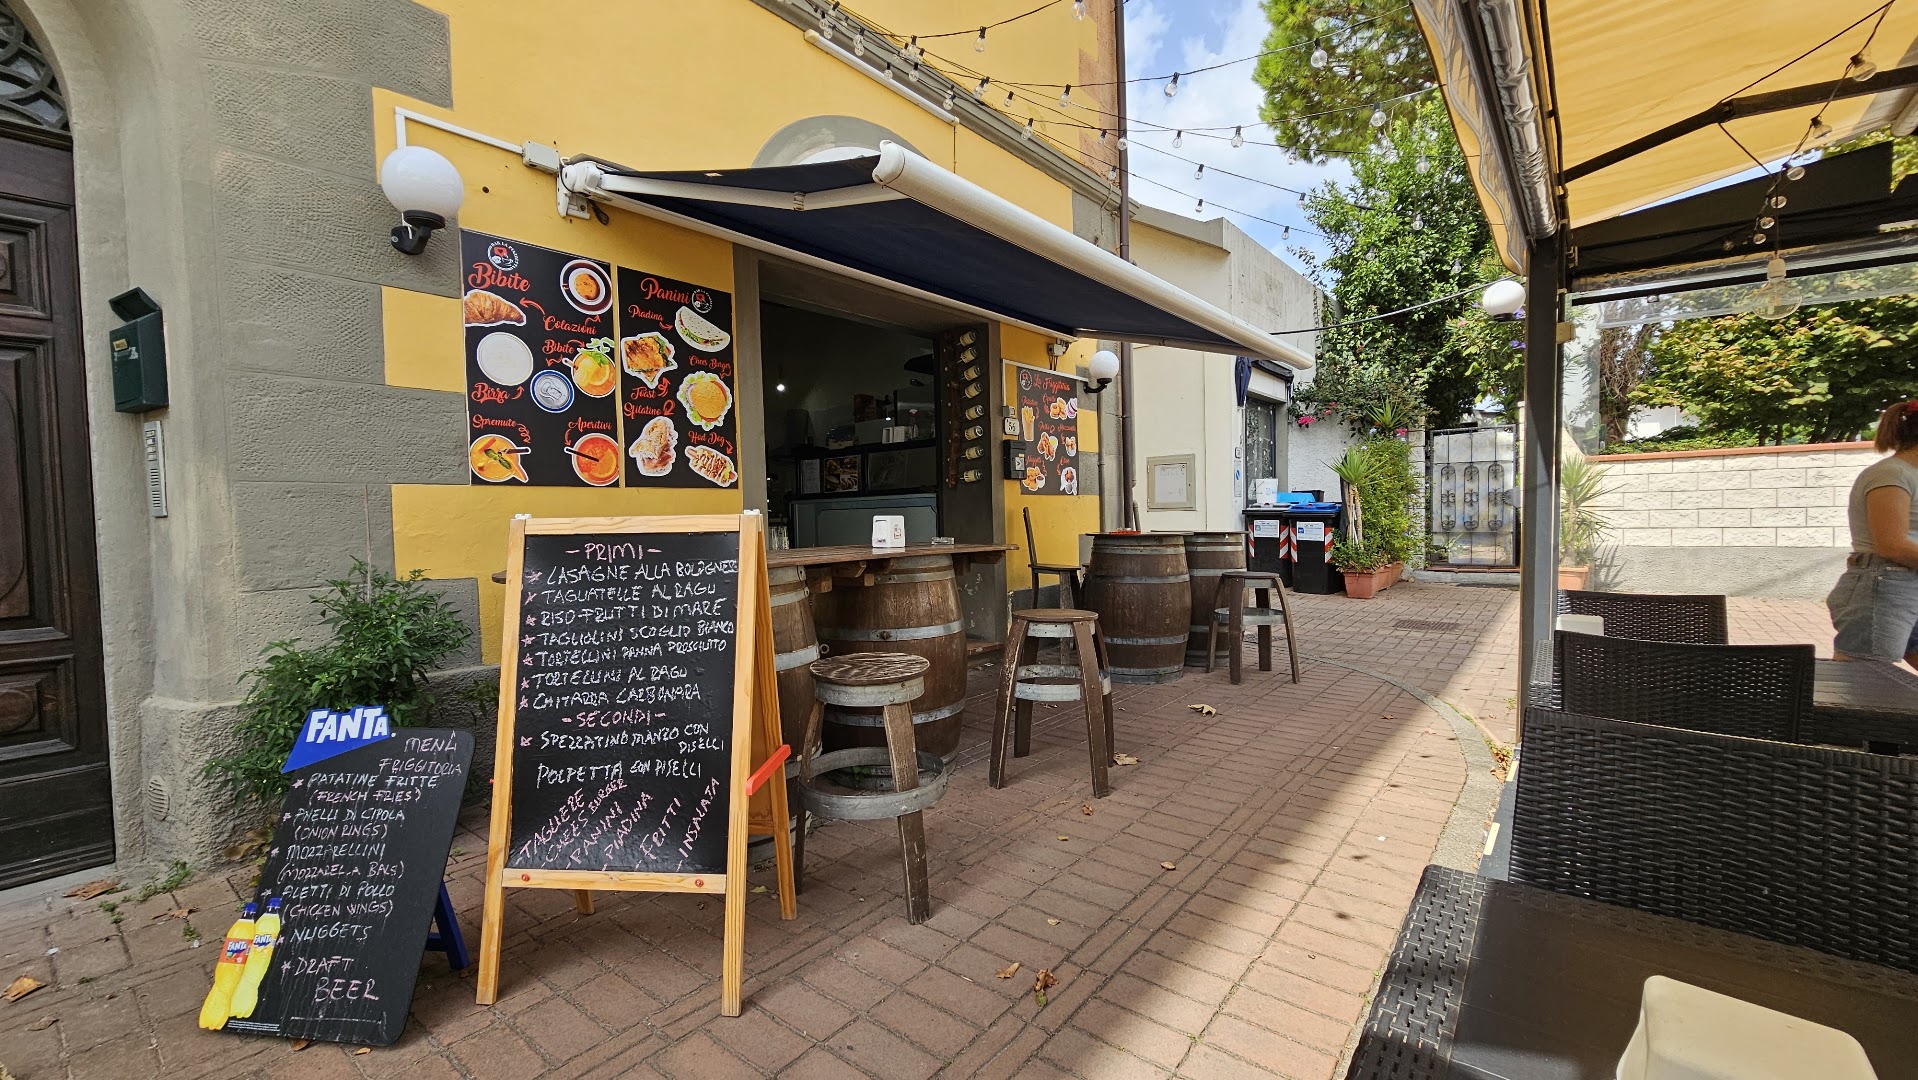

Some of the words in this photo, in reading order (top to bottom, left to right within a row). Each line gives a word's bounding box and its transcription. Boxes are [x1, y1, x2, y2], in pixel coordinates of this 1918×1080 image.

[468, 262, 530, 292] Bibite
[640, 277, 690, 304] Panini
[628, 304, 663, 322] Piadina
[544, 316, 596, 335] Colazioni
[542, 339, 574, 354] Bibite
[472, 382, 510, 403] Birra
[630, 386, 656, 400] Toast
[624, 402, 662, 419] Sfilatino
[472, 414, 517, 429] Spremute
[568, 417, 612, 432] Aperitivi
[708, 432, 725, 448] Dog
[547, 564, 631, 584] LASAGNE
[634, 562, 670, 580] ALLA
[652, 584, 672, 600] AL
[675, 582, 716, 598] RAGU
[540, 610, 576, 626] RISO
[652, 605, 668, 618] DI
[673, 598, 728, 619] MARE
[535, 648, 616, 666] TORTELLINI
[628, 666, 646, 683] AL
[650, 665, 688, 681] RAGU
[306, 708, 388, 744] FANTA
[541, 730, 628, 750] SPEZZATINO
[631, 727, 679, 746] MANZO
[684, 723, 708, 736] CON
[379, 758, 462, 776] FRIGGITORIA
[536, 760, 622, 788] POLPETTA
[630, 760, 650, 774] CON
[654, 758, 700, 778] PISELLI
[307, 773, 378, 788] PATATINE
[386, 776, 440, 788] FRITTE
[293, 808, 339, 825] ANELLI
[342, 808, 356, 822] DI
[361, 808, 405, 820] CIPOLA
[341, 823, 388, 840] RINGS)
[286, 843, 386, 860] MOZZARELLINI
[340, 884, 351, 898] DI
[356, 881, 394, 899] POLLO
[290, 922, 372, 942] NUGGETS
[294, 956, 354, 976] DRAFT
[315, 977, 379, 1002] BEER
